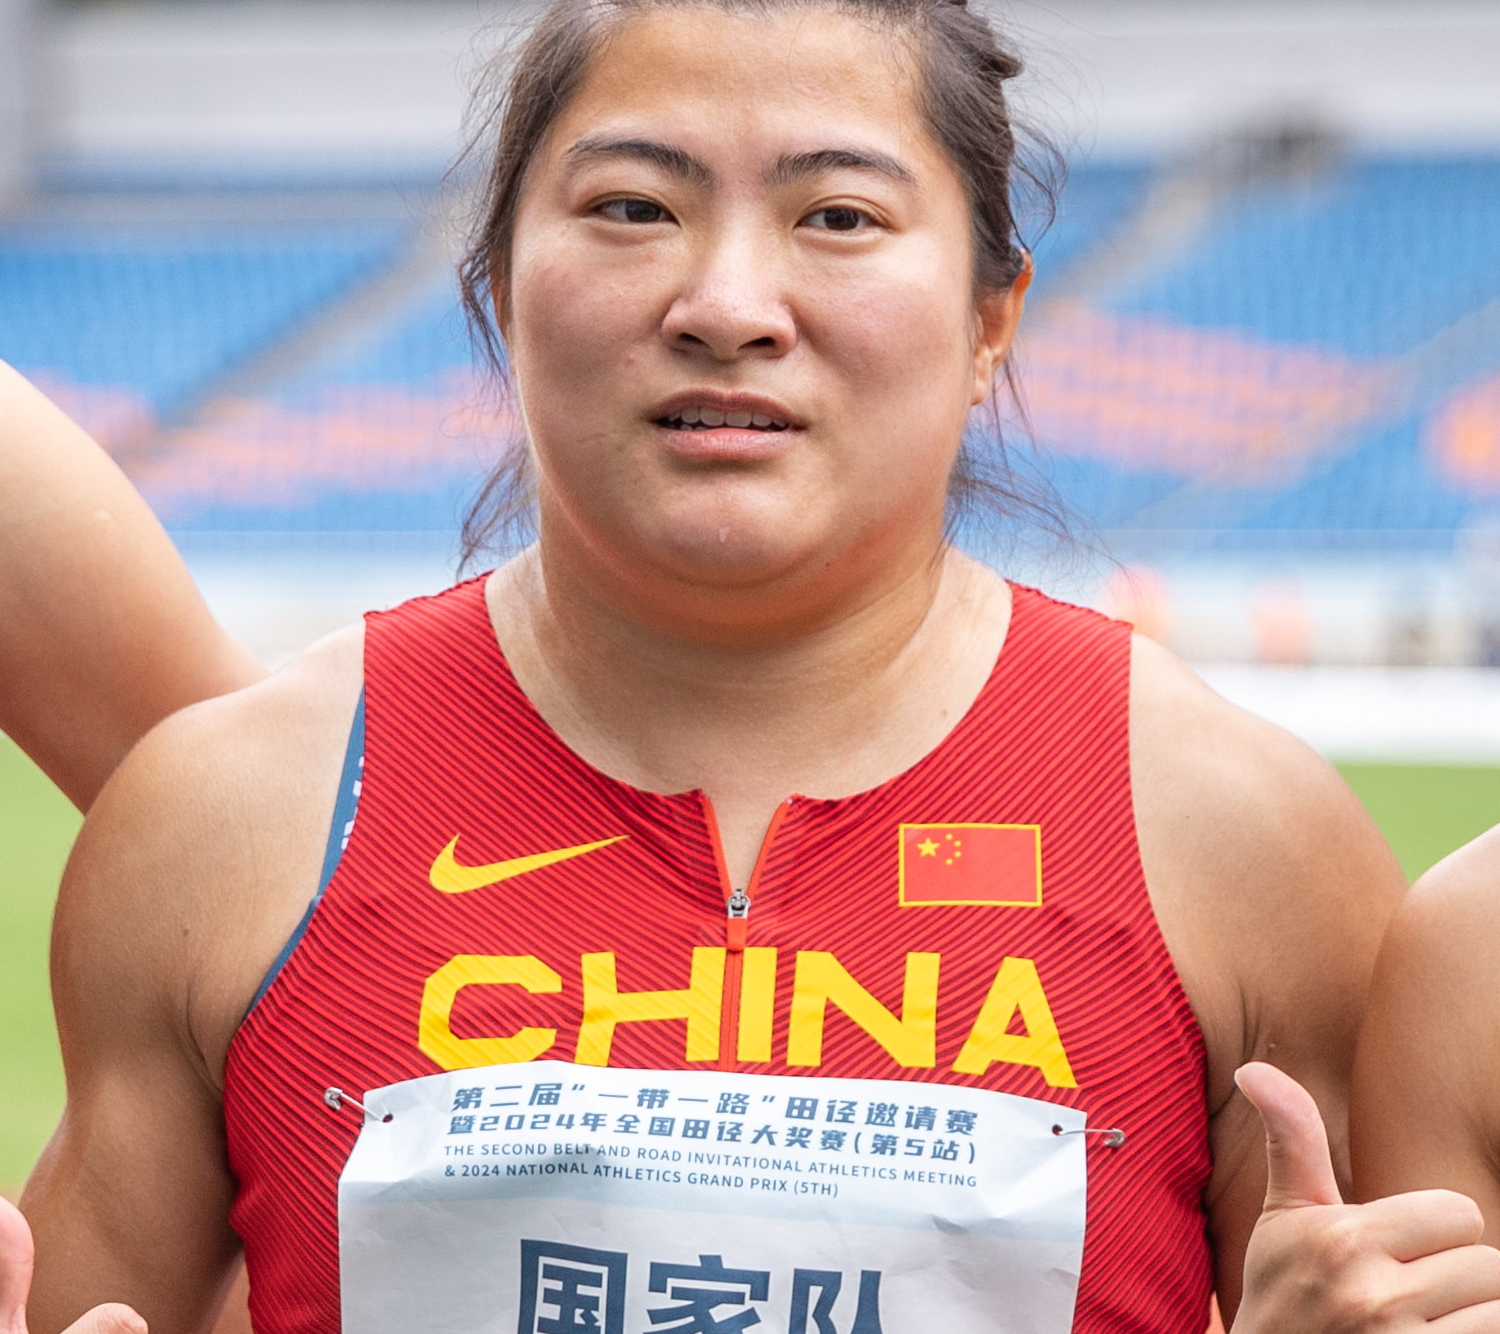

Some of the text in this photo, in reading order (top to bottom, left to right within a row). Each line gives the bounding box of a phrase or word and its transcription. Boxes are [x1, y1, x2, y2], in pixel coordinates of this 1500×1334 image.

[418, 945, 1078, 1089] CHINA
[444, 1143, 978, 1187] THE SECOND BELT AND ROAD INVITATIONAL ATHLETICS MEETING
[444, 1163, 839, 1198] & 2024 NATIONAL ATHLETICS GRAND PRIX (5TH)
